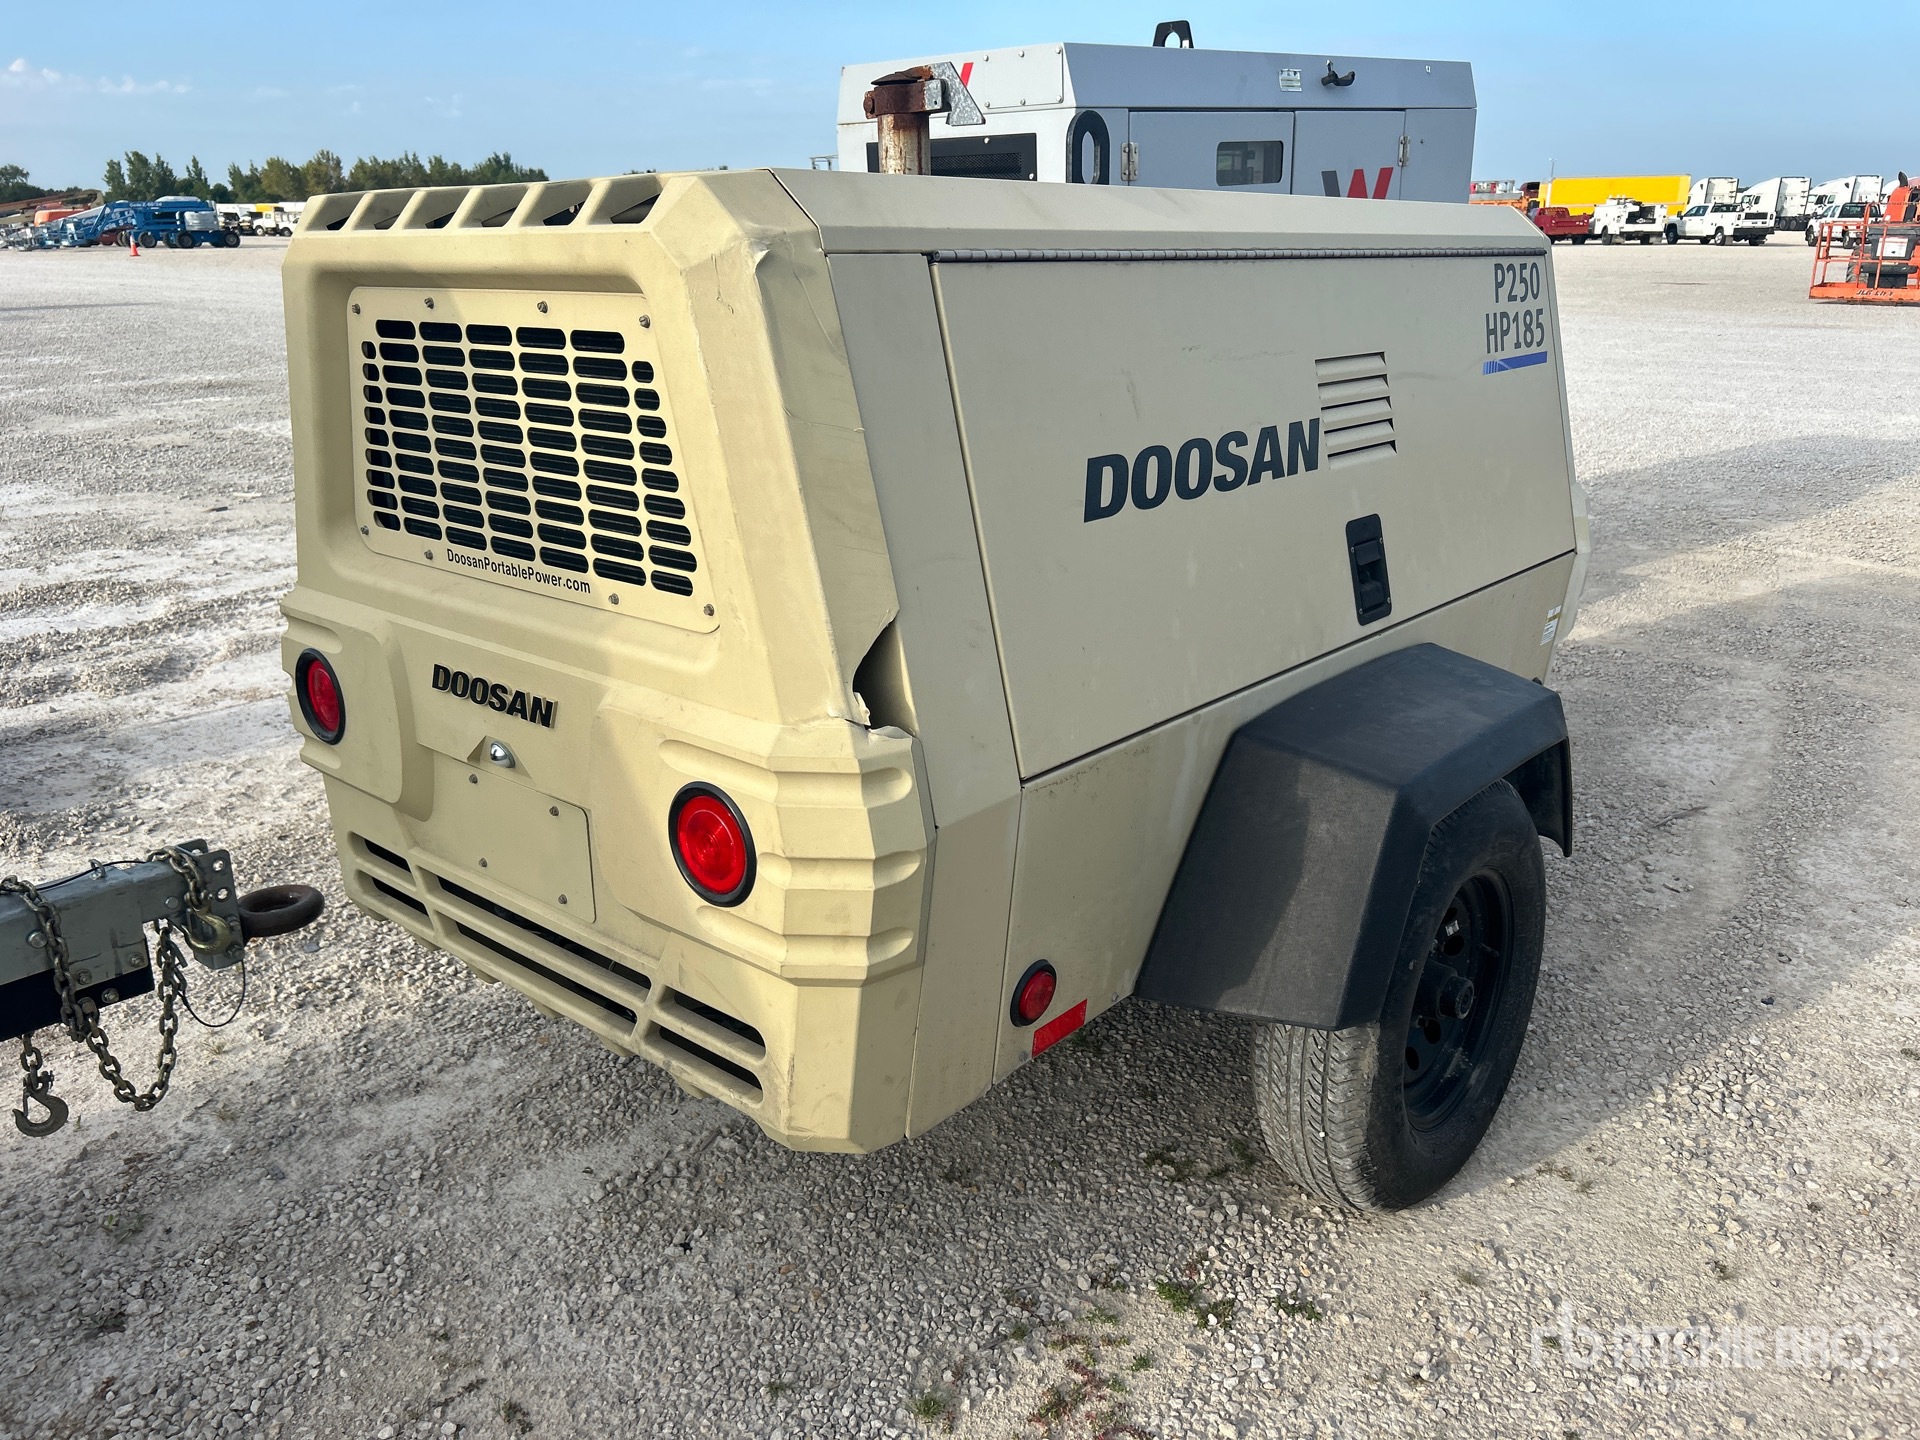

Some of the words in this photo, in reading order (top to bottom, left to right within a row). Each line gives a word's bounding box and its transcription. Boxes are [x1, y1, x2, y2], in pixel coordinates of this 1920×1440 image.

[1494, 262, 1540, 303] P250
[1485, 308, 1545, 354] HP185
[1083, 417, 1320, 523] DOOSAN
[446, 548, 591, 594] DoosanPortablePower.com
[431, 663, 559, 729] DOOSAN
